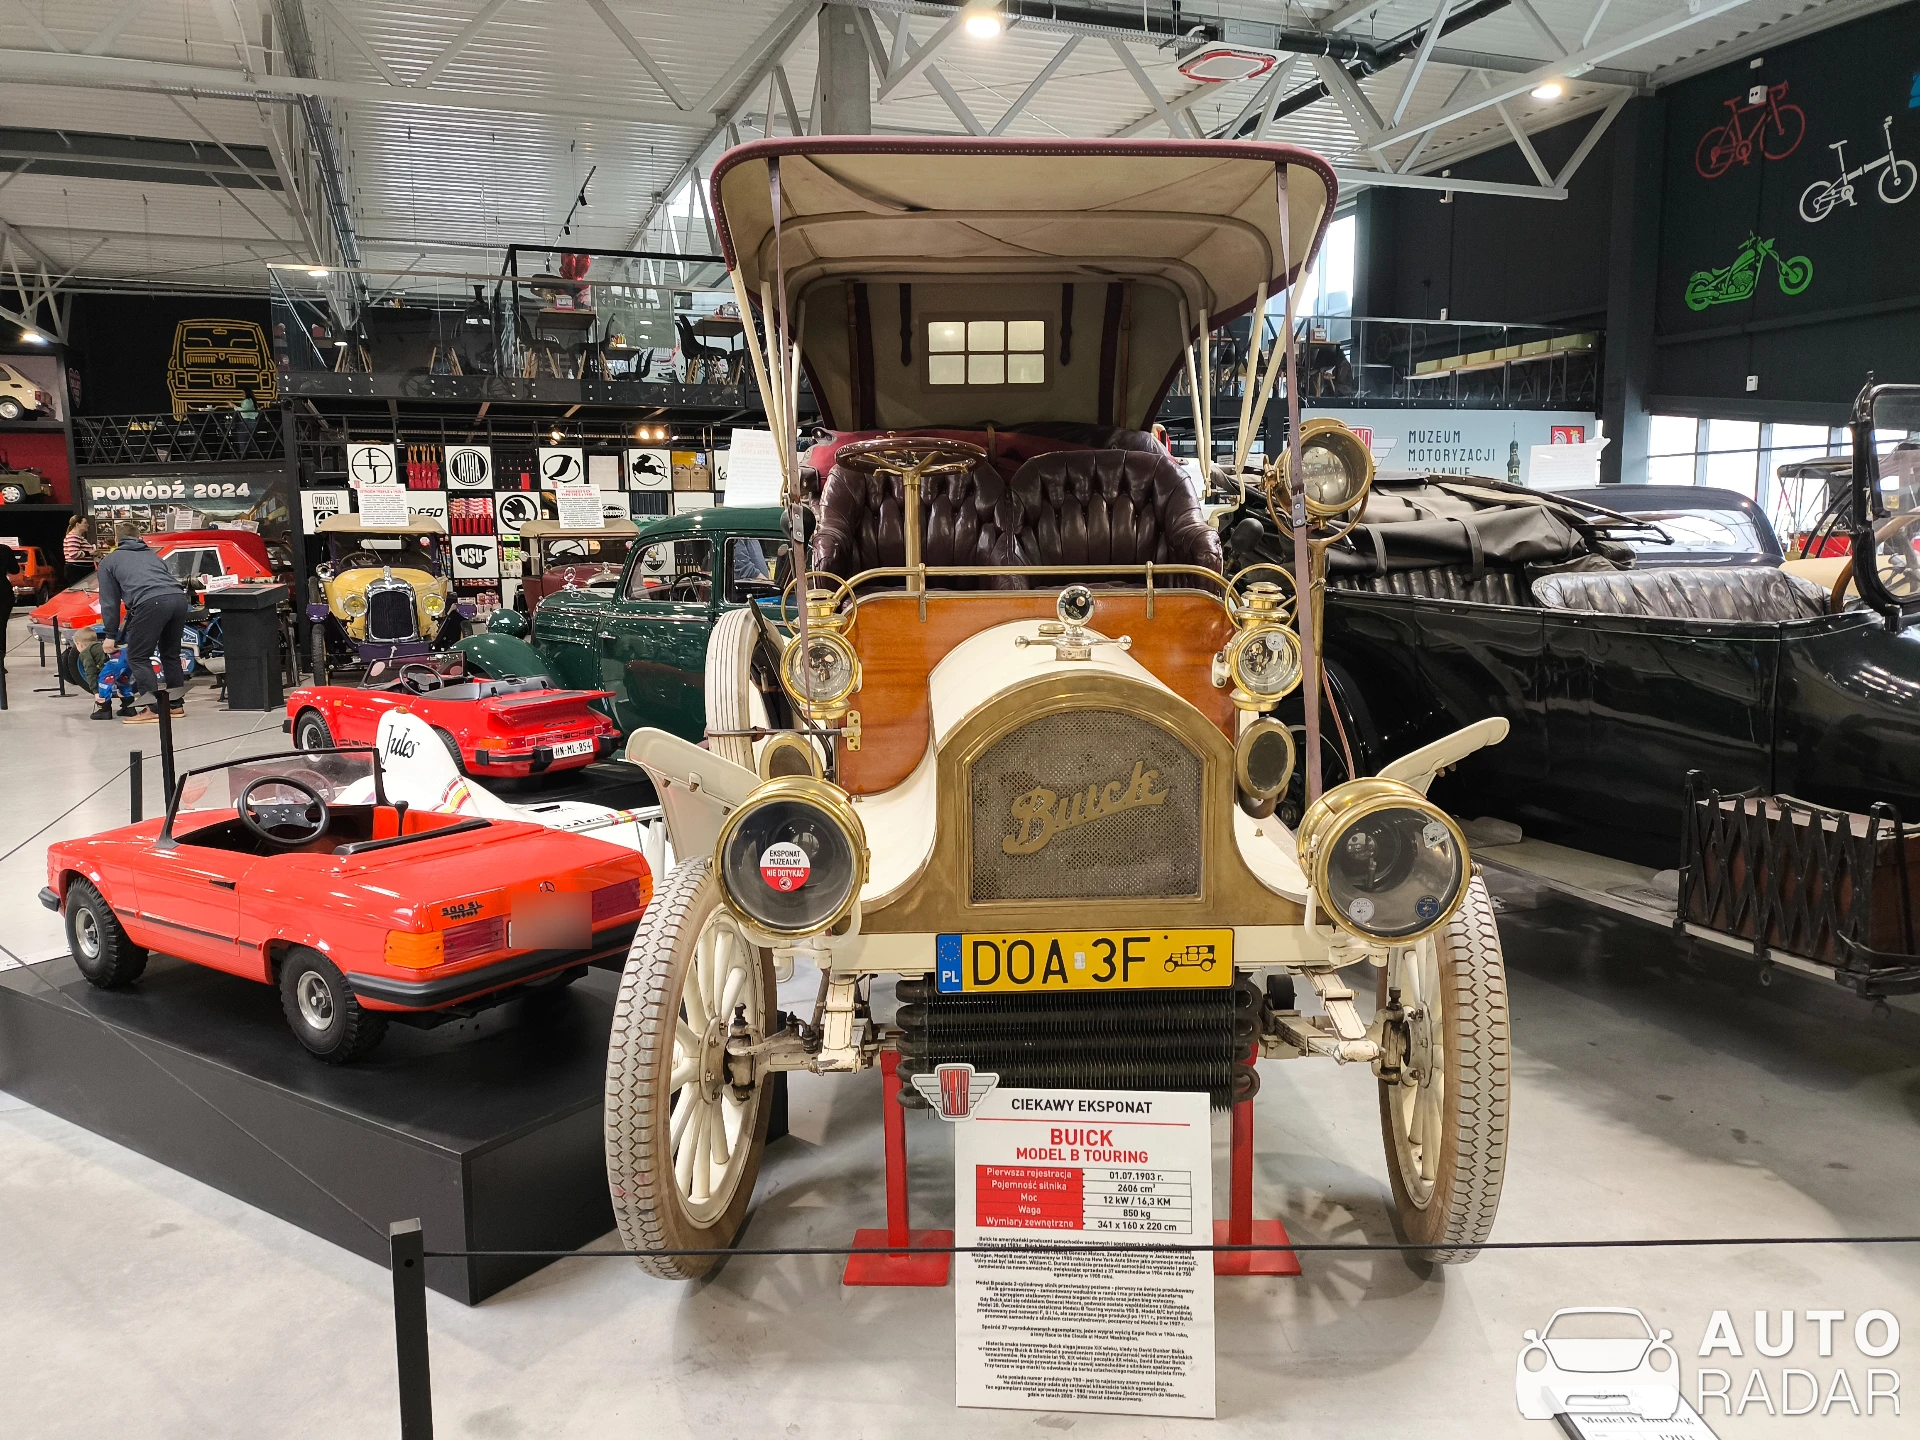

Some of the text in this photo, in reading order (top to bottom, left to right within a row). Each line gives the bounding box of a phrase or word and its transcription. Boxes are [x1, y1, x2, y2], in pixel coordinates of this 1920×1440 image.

[1409, 430, 1460, 443] MUZEUM
[1408, 449, 1495, 462] MOTORYZACJI
[92, 480, 250, 500] POWÓDŹ 2024
[460, 548, 483, 564] NSU
[537, 730, 594, 742] PORSCHE
[380, 724, 420, 765] Jules
[1002, 760, 1170, 854] Buick
[778, 868, 804, 877] DOTYKAĆ
[442, 904, 464, 915] 500
[942, 936, 1151, 985] PL DOA 3F
[1011, 1098, 1153, 1114] CIEKAWY EKSPONAT
[1050, 1128, 1113, 1147] BUICK
[1016, 1148, 1148, 1163] MODEL B TOURING
[986, 1168, 1072, 1180] Pierwsza rejestracja
[1109, 1171, 1155, 1181] 01.07.1903
[991, 1180, 1067, 1191] Pojemność silnika
[1118, 1184, 1138, 1193] 2606
[1020, 1193, 1038, 1203] Moc
[1103, 1196, 1113, 1205] 12
[1115, 1196, 1129, 1205] kW
[1137, 1196, 1154, 1207] 16,3
[1156, 1197, 1171, 1206] KM
[1018, 1205, 1041, 1216] Waga
[1123, 1209, 1151, 1220] 850 kg
[985, 1217, 1074, 1230] Wymiary zewnętrzne
[1097, 1221, 1112, 1230] 341
[1122, 1221, 1137, 1230] 160
[1146, 1222, 1163, 1231] 220
